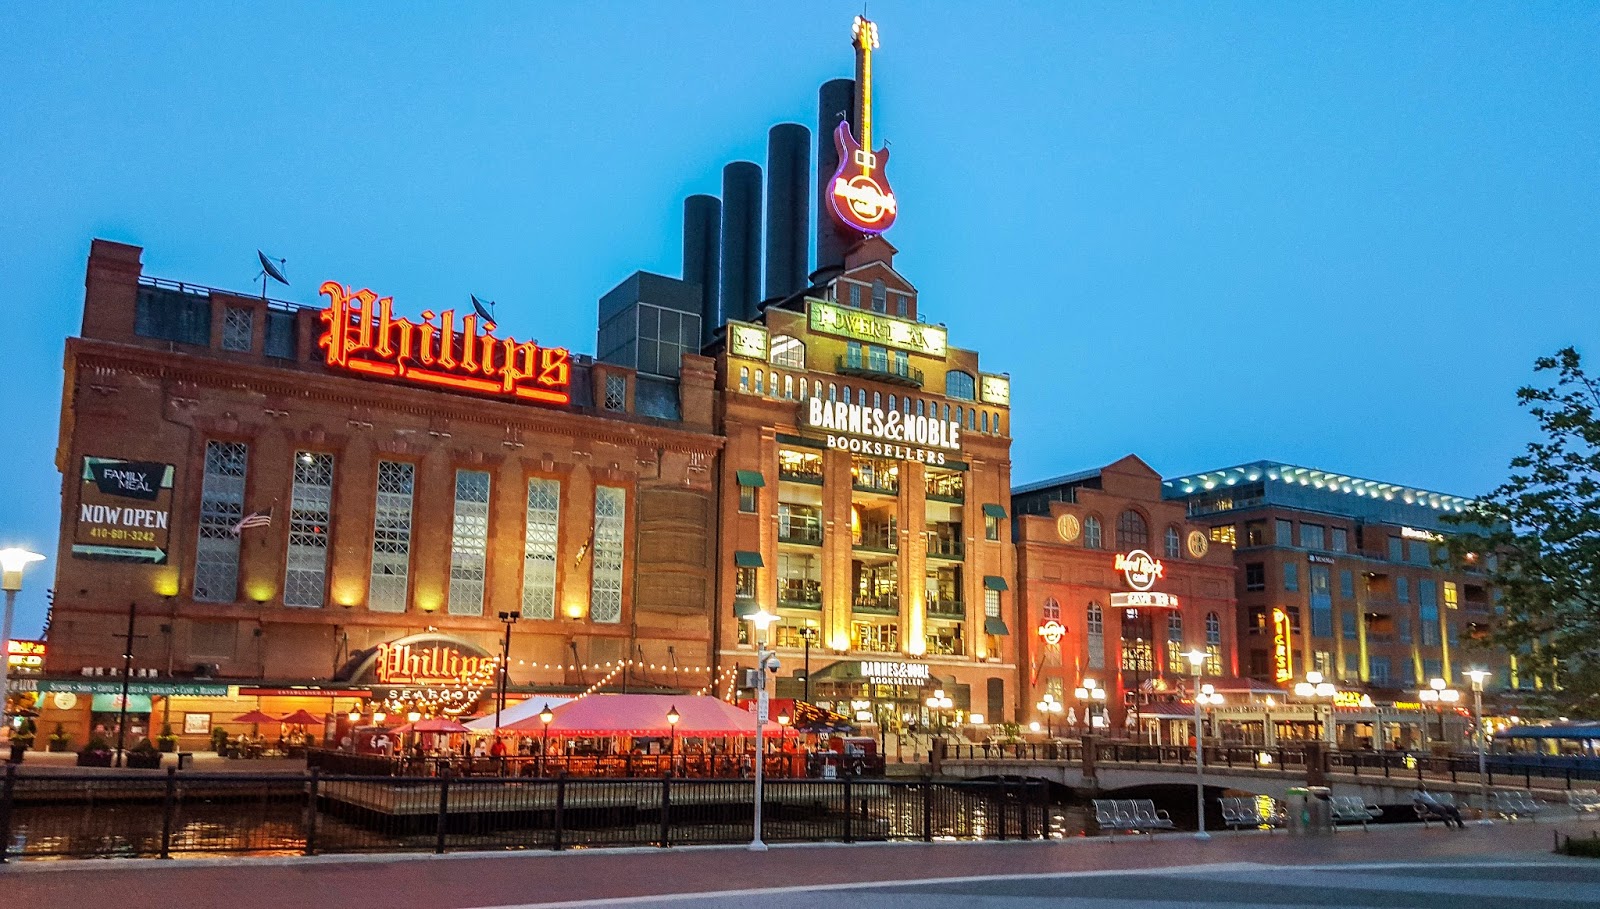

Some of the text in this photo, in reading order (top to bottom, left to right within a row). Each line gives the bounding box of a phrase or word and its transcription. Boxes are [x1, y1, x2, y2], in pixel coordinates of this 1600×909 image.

[819, 306, 881, 338] POWER
[319, 281, 569, 394] Phillips
[827, 434, 945, 465] BOOKSELLERS
[103, 468, 147, 482] FAMILY
[118, 480, 153, 492] MEAL
[81, 503, 168, 529] NOW OPEN
[90, 527, 155, 542] 410-601-3242
[1115, 554, 1140, 571] Hard
[376, 643, 494, 684] Phillips
[870, 676, 925, 686] BOOKSELLERS
[389, 689, 478, 699] SEAFOOD
